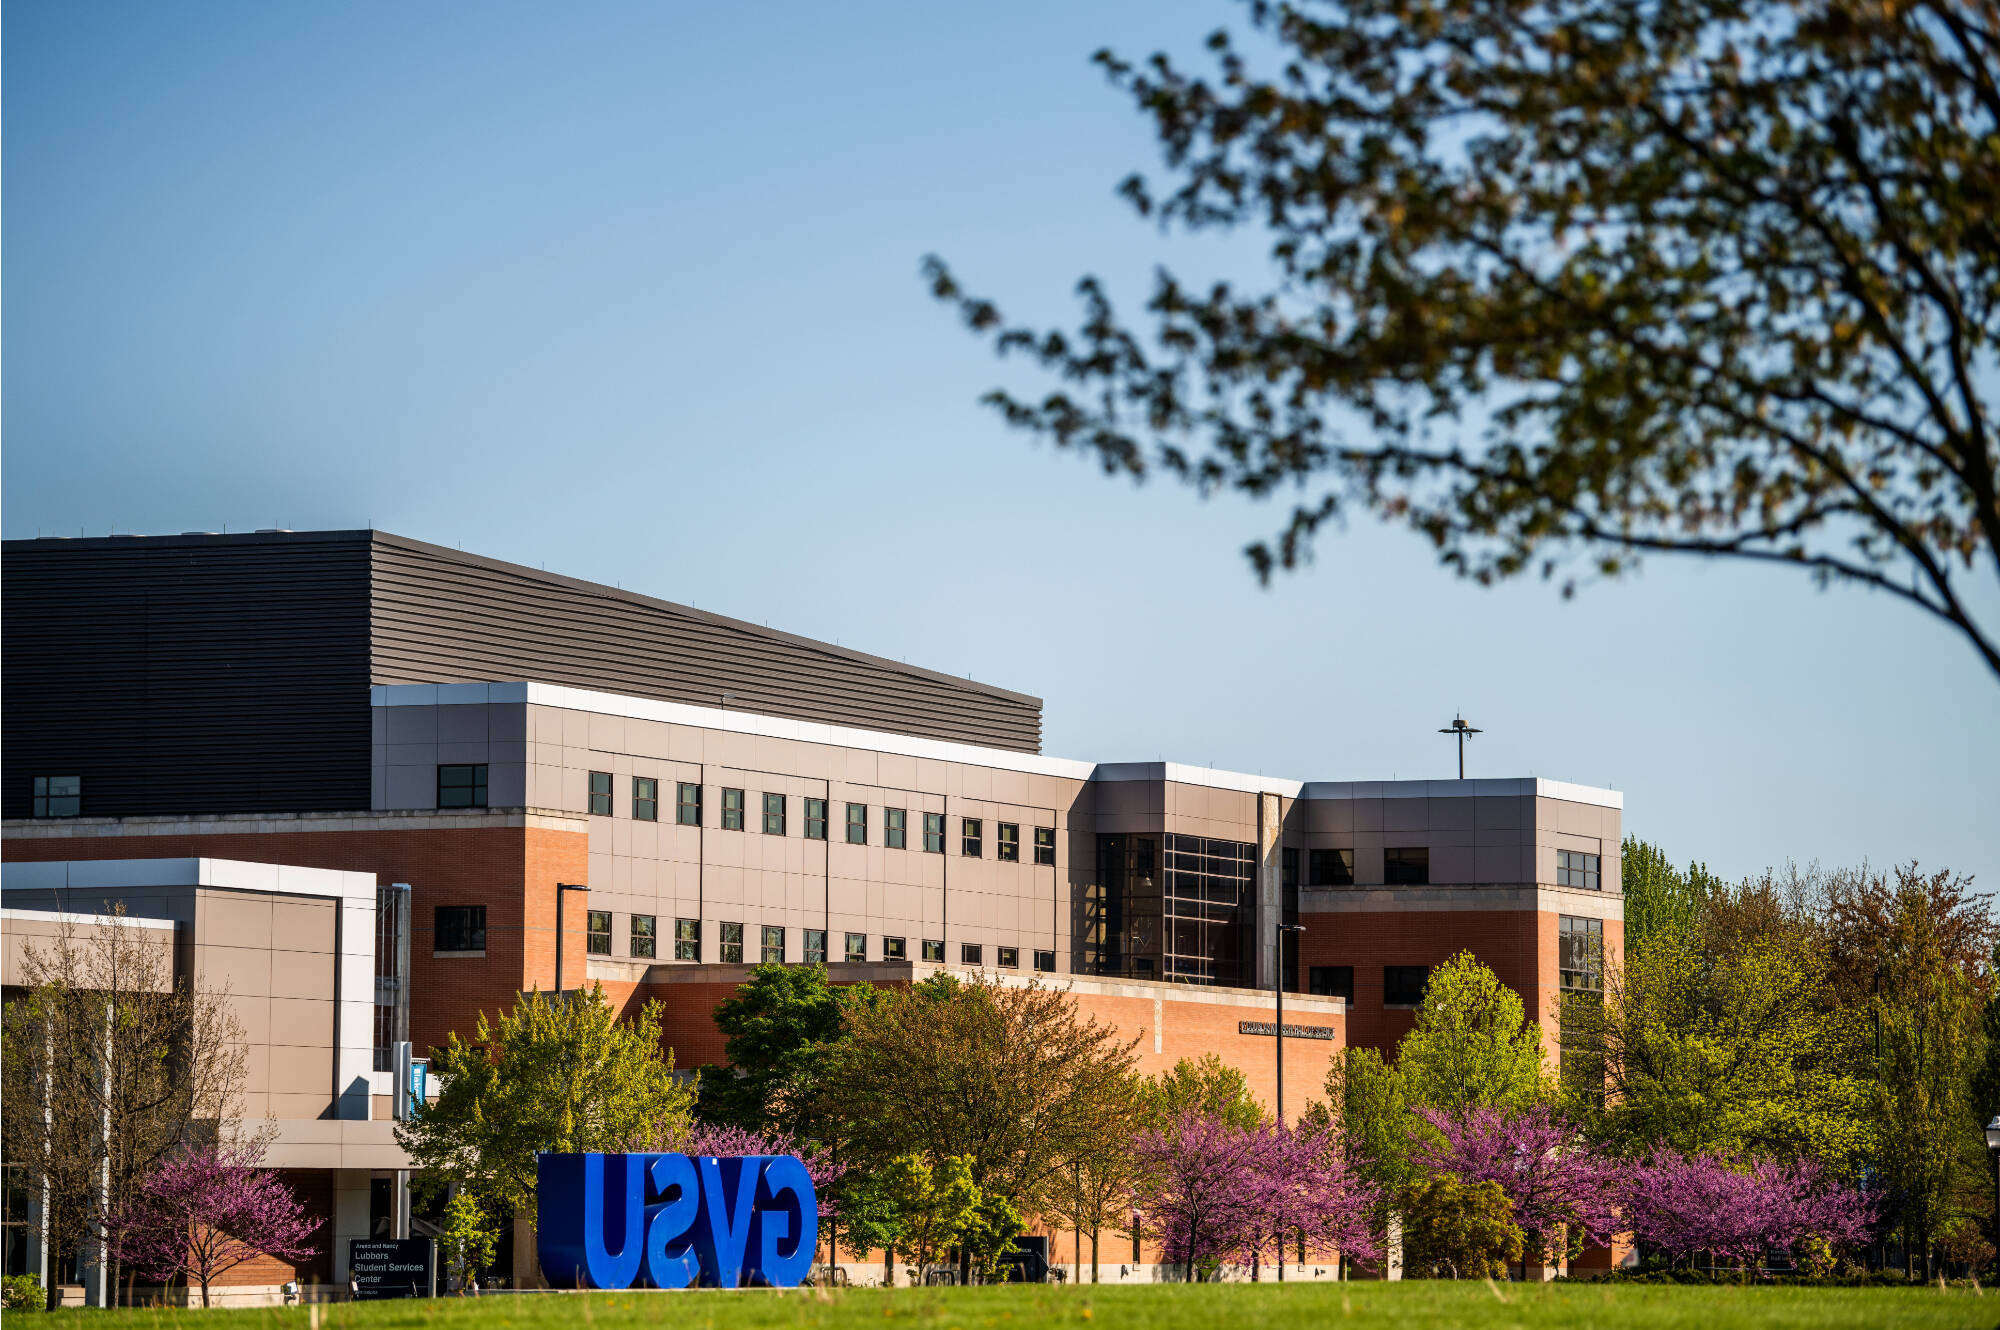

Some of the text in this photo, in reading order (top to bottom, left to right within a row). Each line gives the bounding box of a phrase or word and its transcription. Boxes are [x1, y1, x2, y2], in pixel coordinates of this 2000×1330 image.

[355, 1251, 389, 1260] Lubbers
[354, 1263, 424, 1272] Student Services
[354, 1274, 382, 1283] Center
